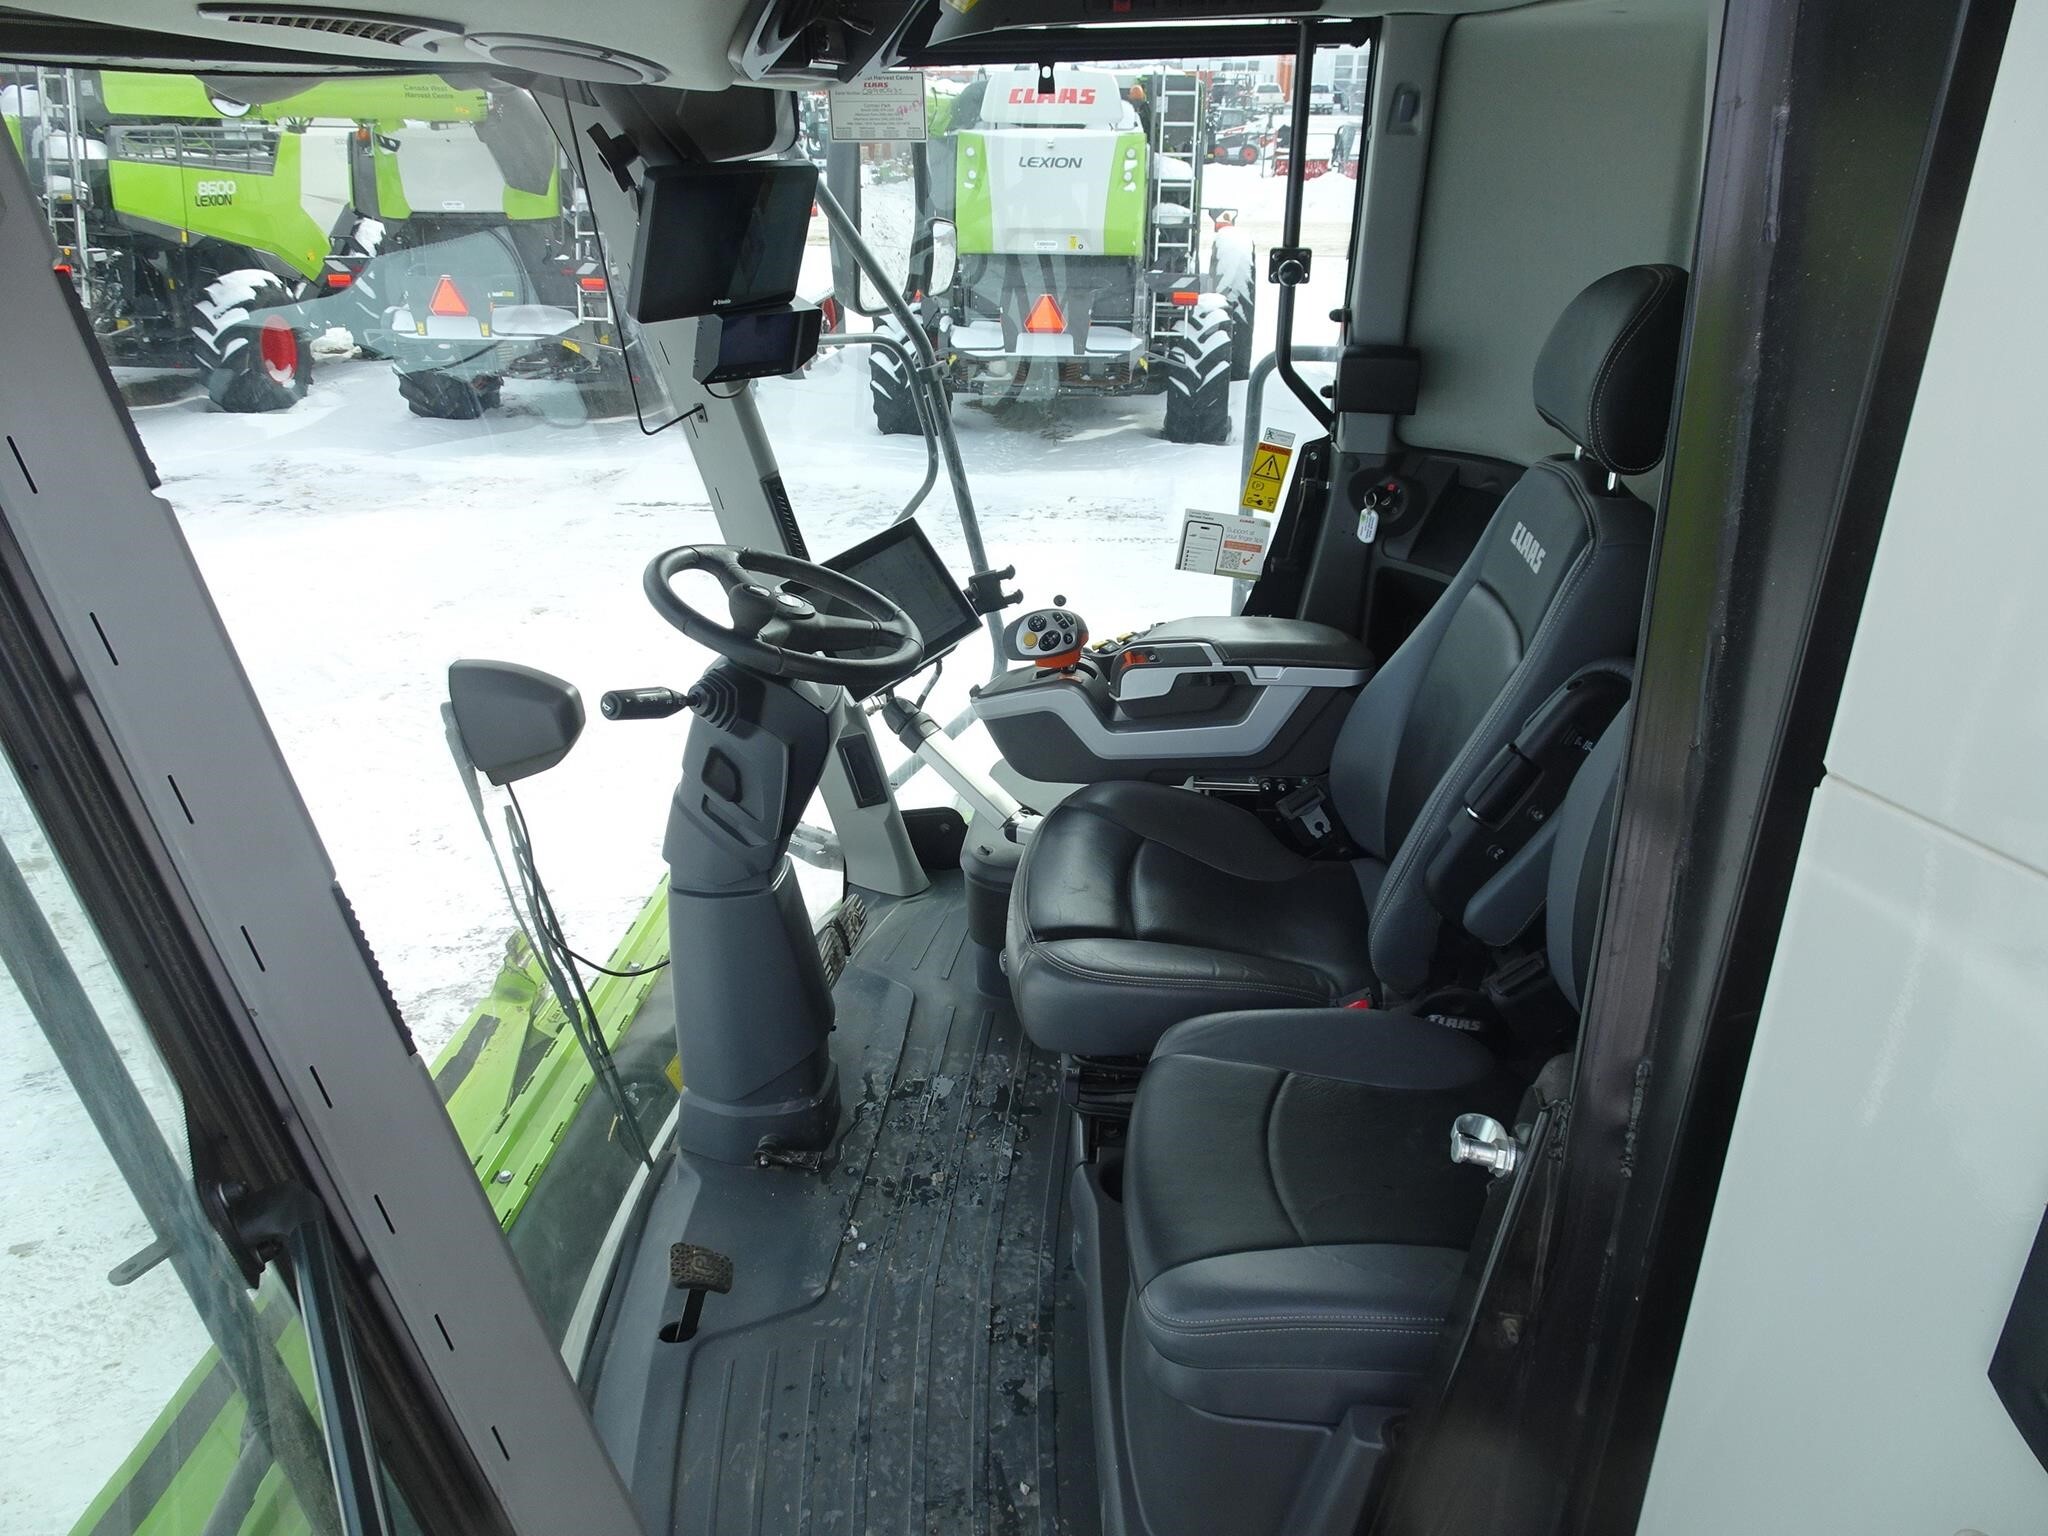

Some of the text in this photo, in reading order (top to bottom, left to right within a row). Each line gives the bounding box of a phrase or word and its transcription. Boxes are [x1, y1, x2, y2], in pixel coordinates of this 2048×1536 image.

[1008, 88, 1096, 105] CLAAS
[1018, 156, 1083, 169] LEXION
[194, 194, 233, 207] LEXION
[1510, 521, 1546, 575] CLAAS
